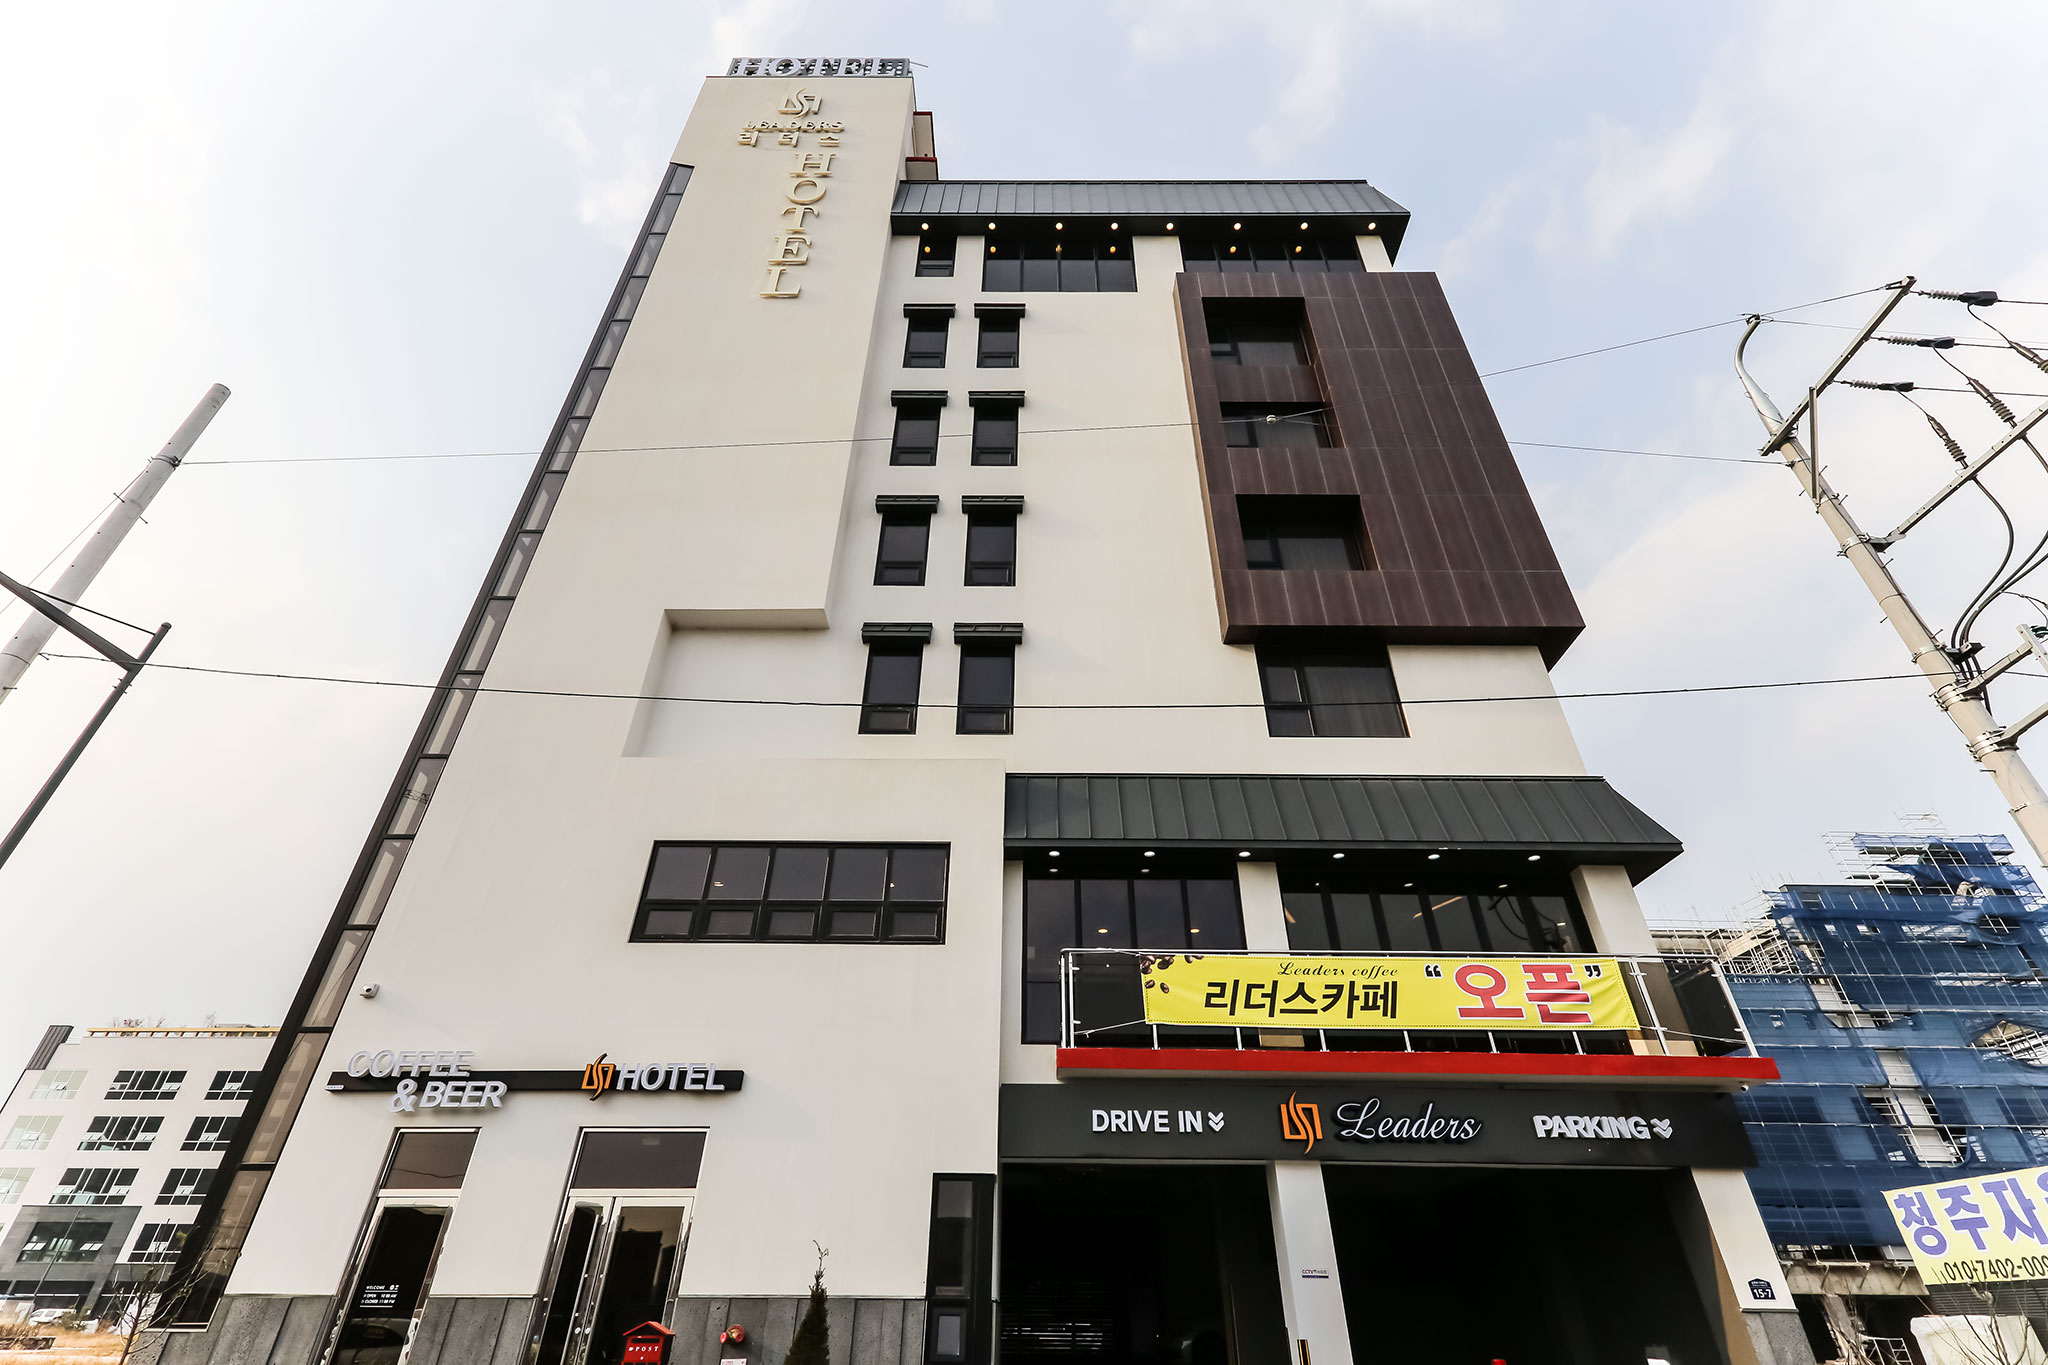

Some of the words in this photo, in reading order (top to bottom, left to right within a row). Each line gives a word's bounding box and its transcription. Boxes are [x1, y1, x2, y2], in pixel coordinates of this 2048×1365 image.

[733, 58, 896, 77] HOTEL
[742, 120, 845, 133] LEADERS
[760, 153, 837, 298] HOTEL
[1277, 961, 1345, 976] Leaders
[1352, 965, 1398, 980] coffee
[1204, 979, 1398, 1018] 리더스카페
[347, 1049, 475, 1078] COFFEE
[616, 1063, 726, 1091] HOTEL
[387, 1078, 418, 1112] &
[419, 1081, 507, 1108] BEER
[1092, 1109, 1170, 1133] DRIVE
[1178, 1110, 1203, 1133] IN
[1336, 1098, 1482, 1141] Leaders
[1532, 1115, 1651, 1140] PARKING
[1893, 1171, 2048, 1256] 청주자
[1753, 1289, 1772, 1298] 15-7
